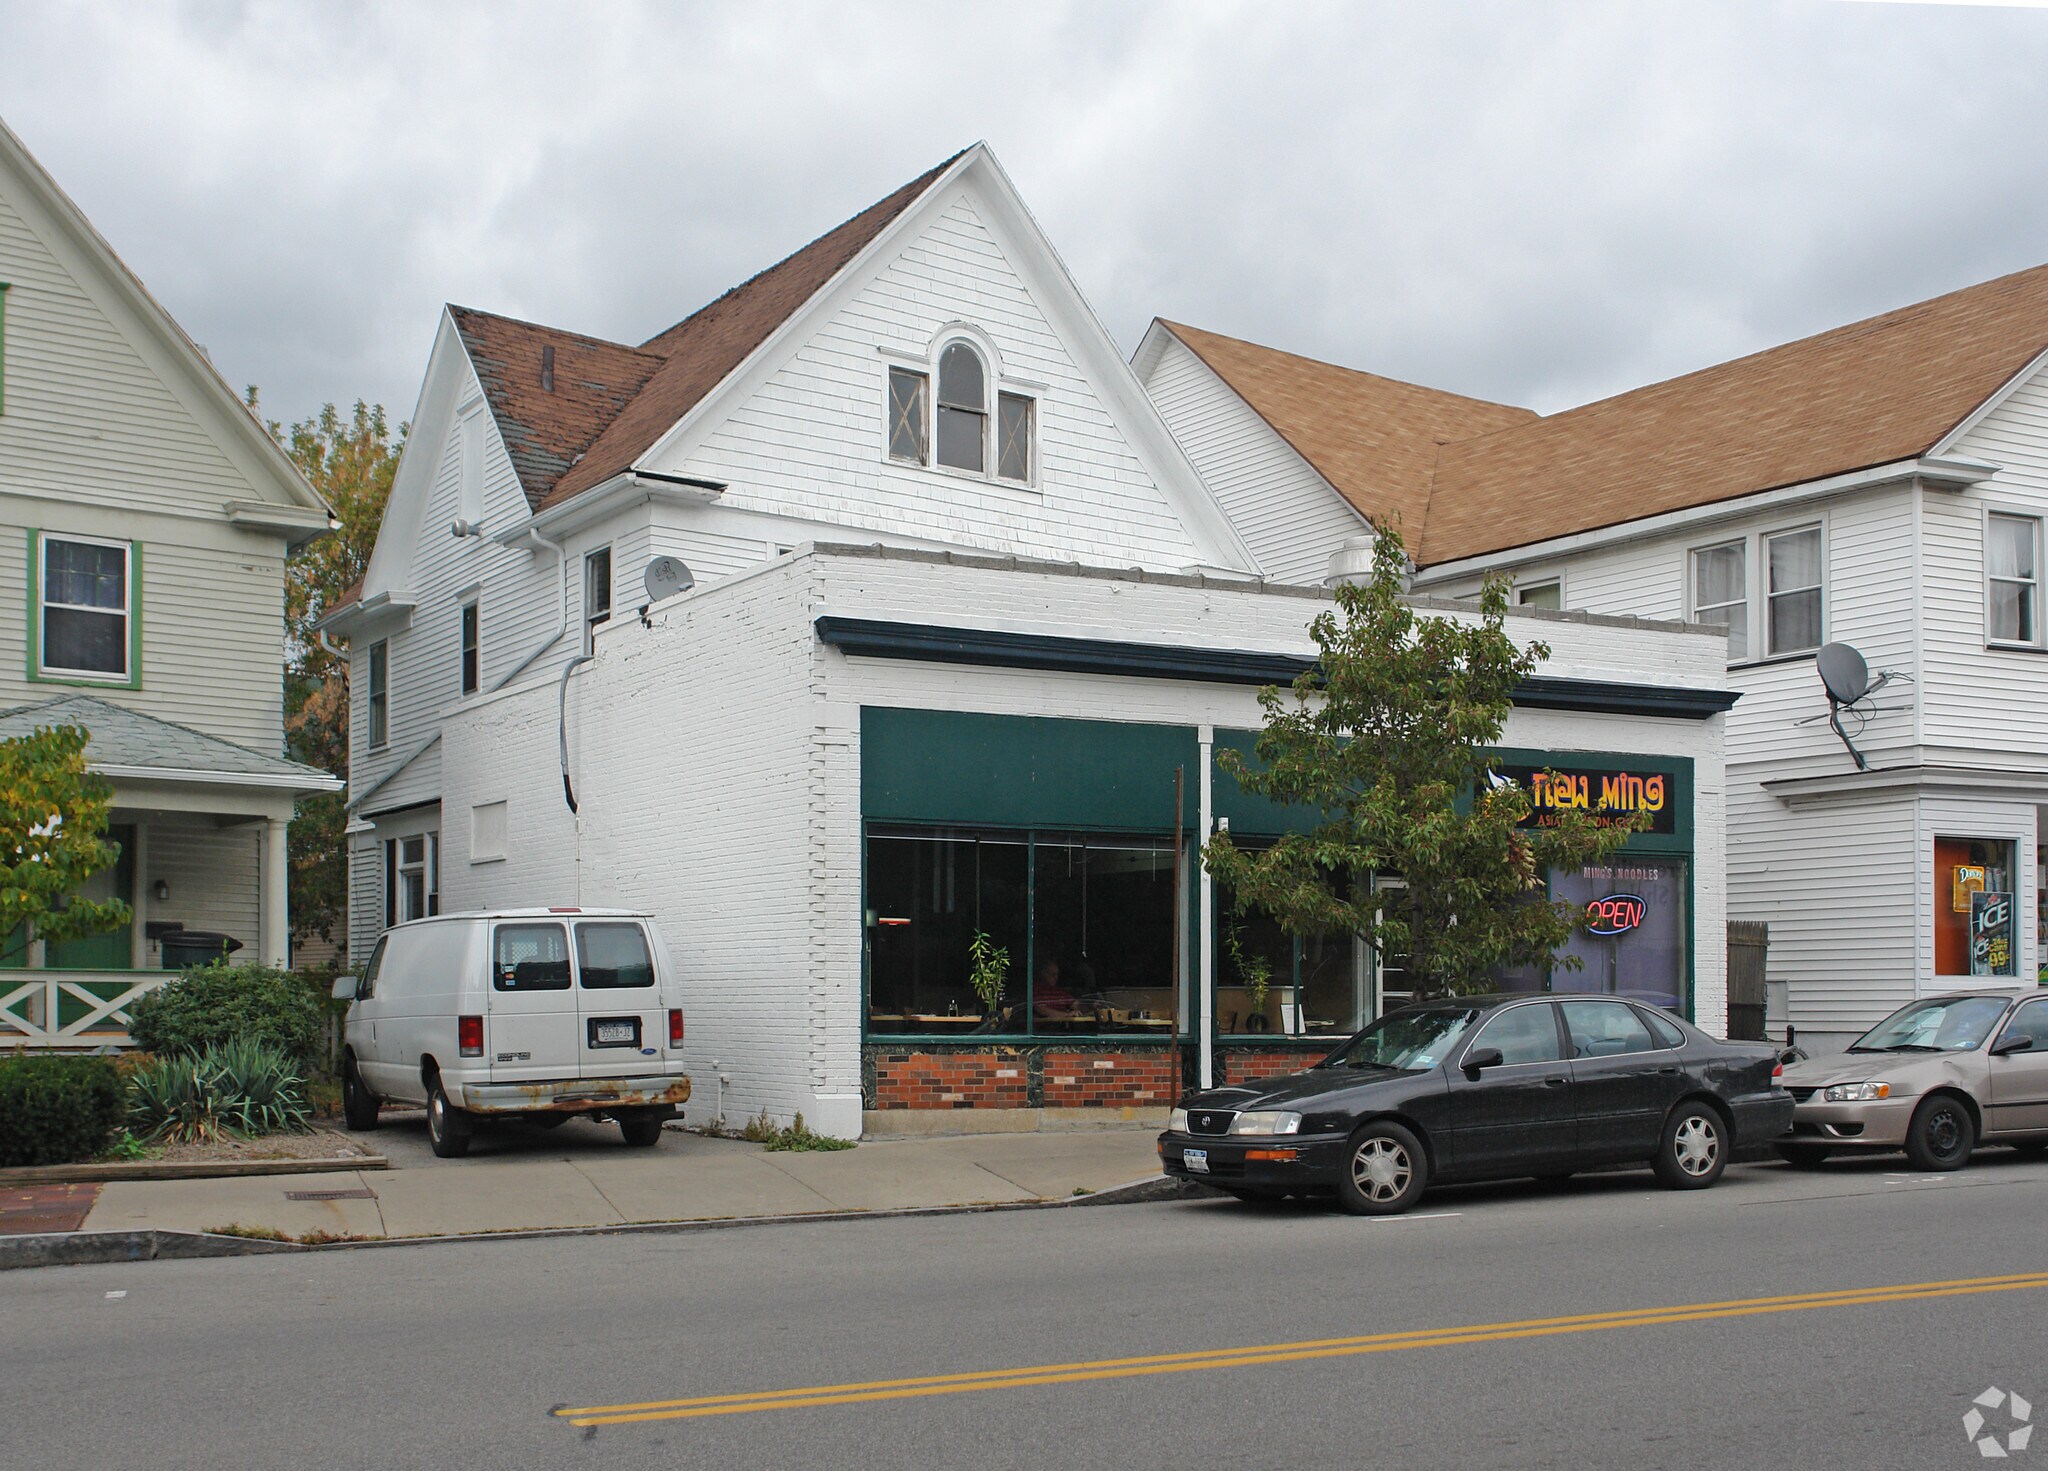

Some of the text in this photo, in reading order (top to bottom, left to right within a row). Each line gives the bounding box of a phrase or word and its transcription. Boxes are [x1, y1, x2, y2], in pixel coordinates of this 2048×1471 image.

[1538, 814, 1565, 828] ASIA
[1617, 868, 1659, 880] NOODLES
[1587, 901, 1642, 928] OPEN
[1978, 901, 2009, 933] ICE
[1974, 938, 1990, 959] ICE
